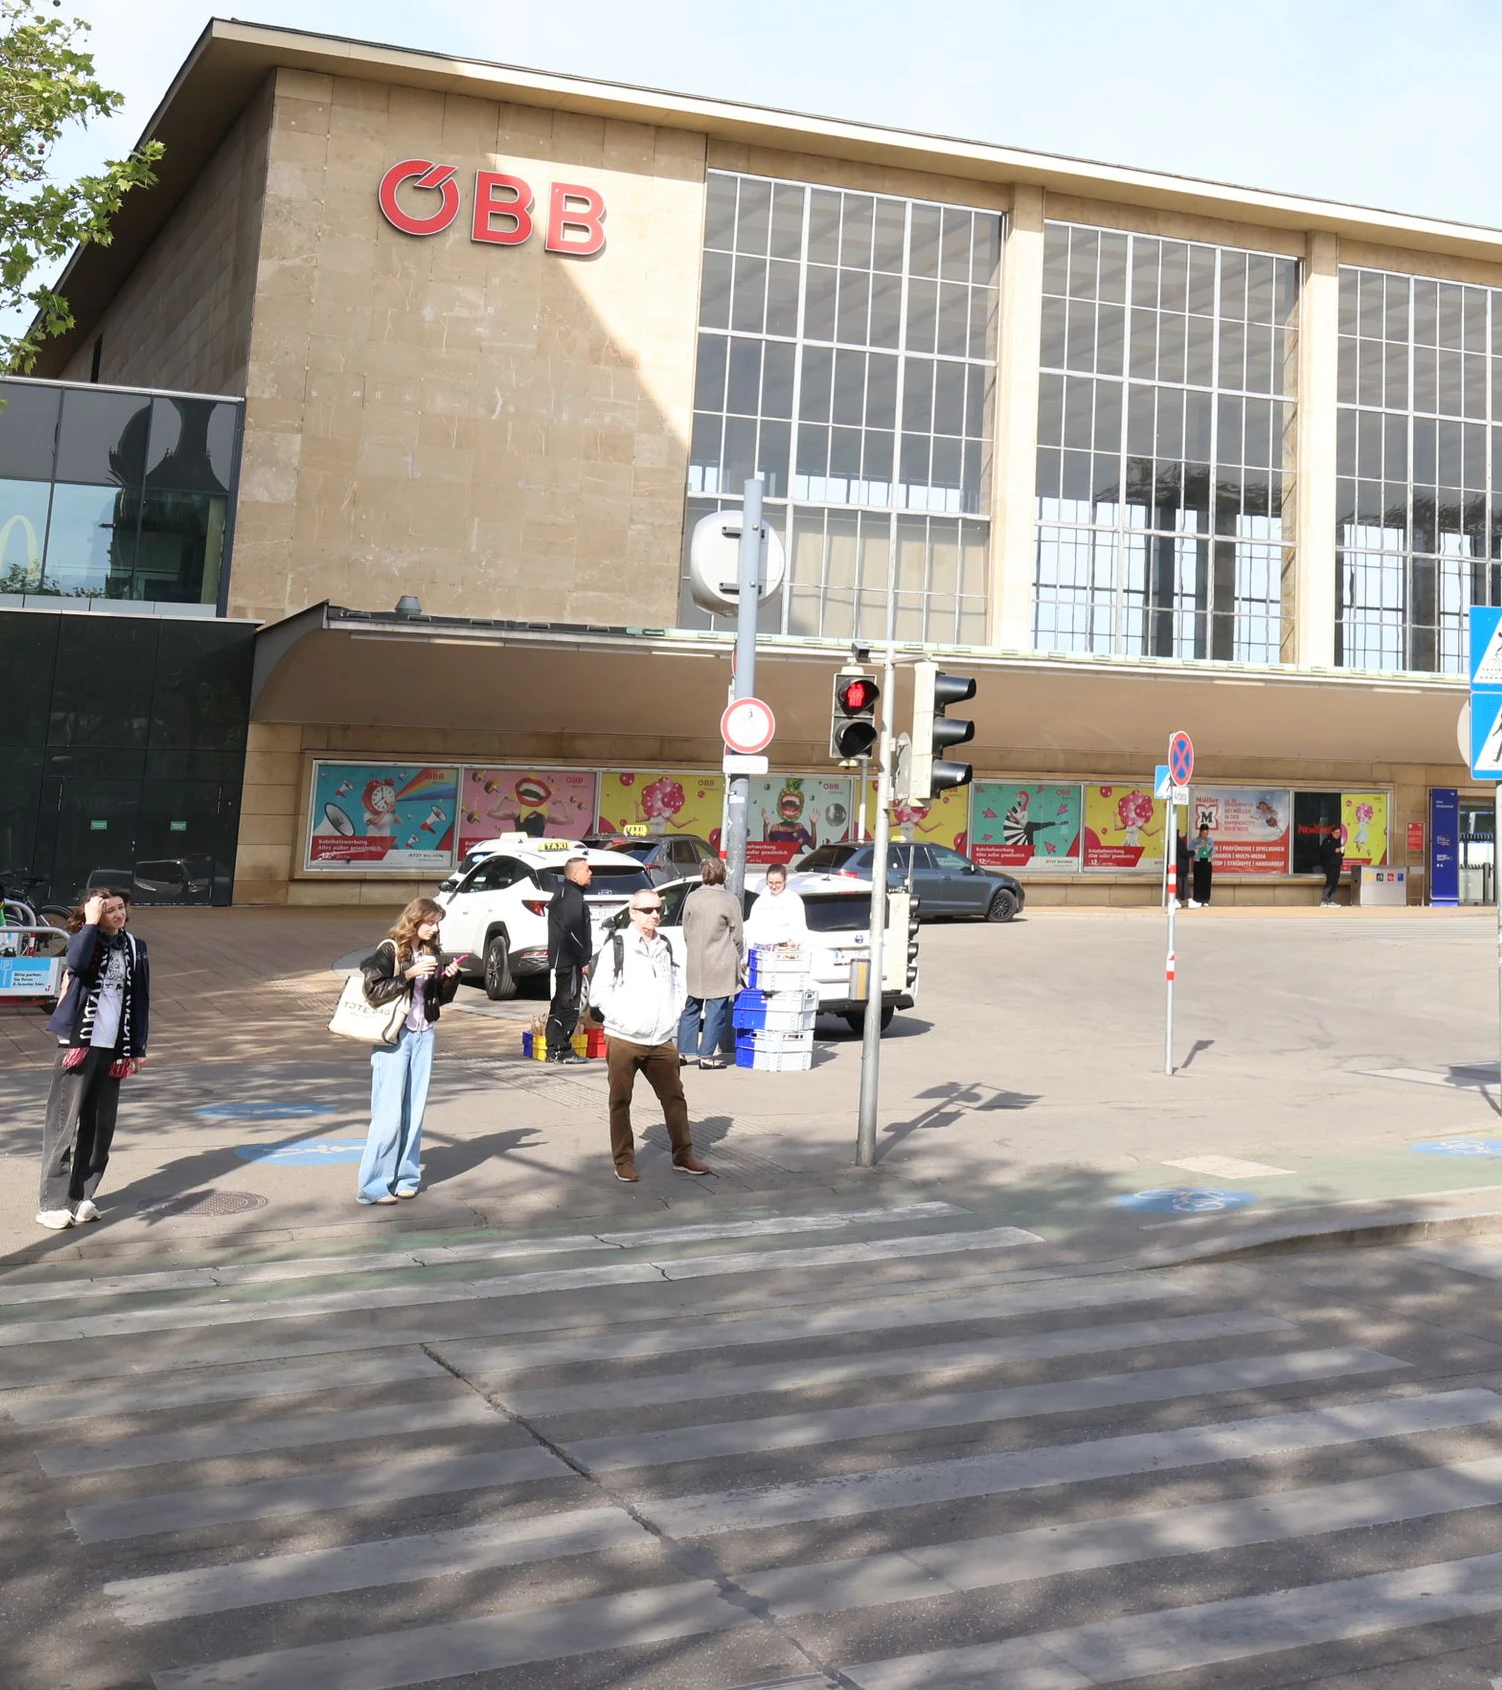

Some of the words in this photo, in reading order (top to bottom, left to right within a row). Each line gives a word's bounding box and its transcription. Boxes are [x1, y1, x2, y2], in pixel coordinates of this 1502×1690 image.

[378, 158, 608, 257] ÖBB
[1195, 796, 1219, 804] Müller
[1201, 811, 1213, 823] M
[545, 841, 568, 851] TAXI
[344, 1001, 370, 1014] TOTE
[372, 1007, 391, 1016] BAG
